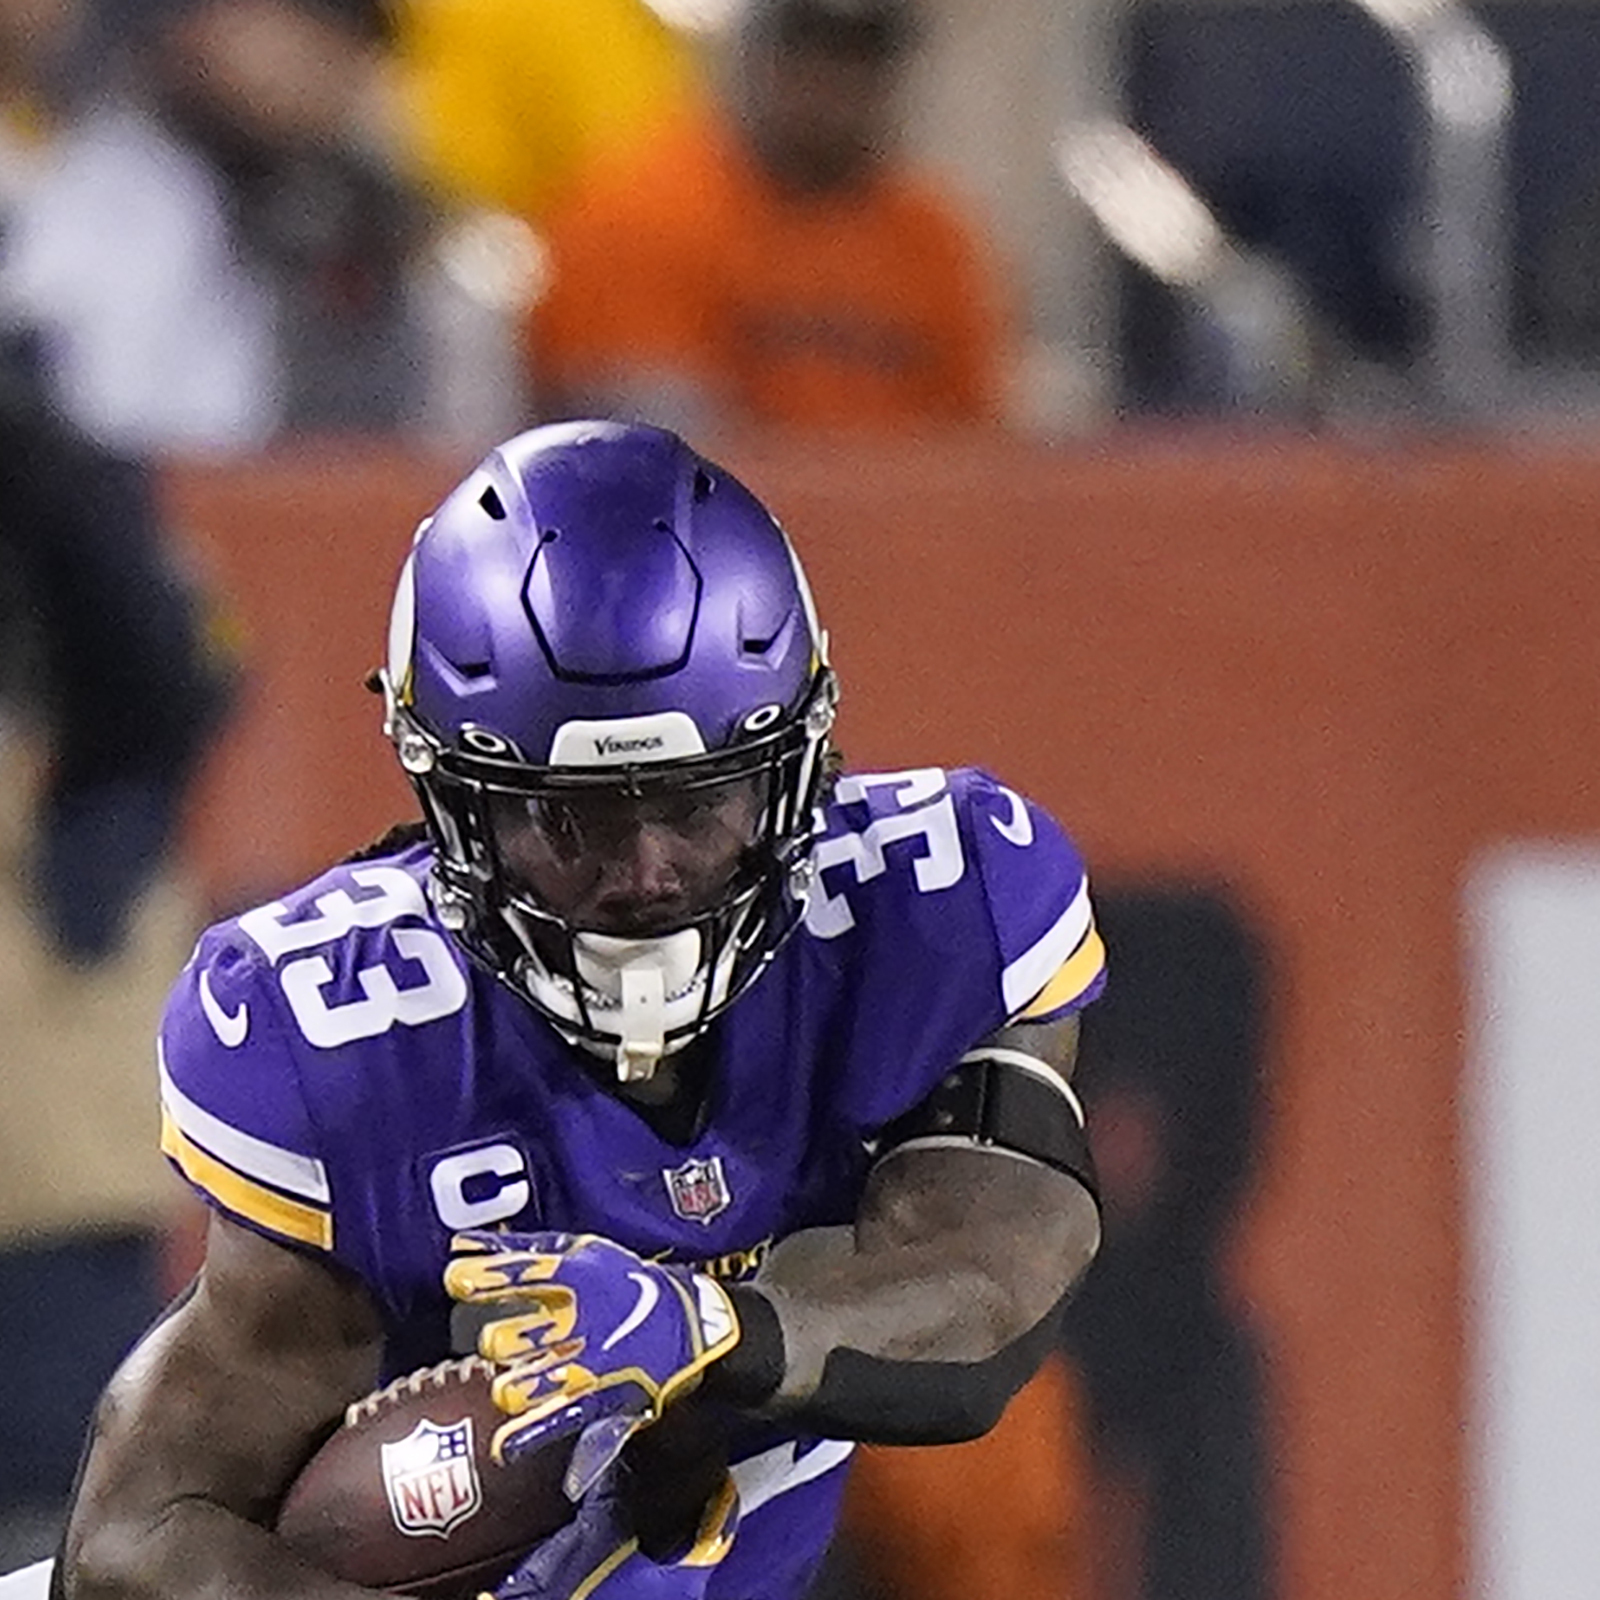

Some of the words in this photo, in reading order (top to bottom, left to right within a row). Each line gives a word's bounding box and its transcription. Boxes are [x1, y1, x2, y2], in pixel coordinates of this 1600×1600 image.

[804, 766, 965, 940] 33
[238, 867, 467, 1048] 33
[430, 1143, 529, 1231] C
[399, 1464, 470, 1521] NFL
